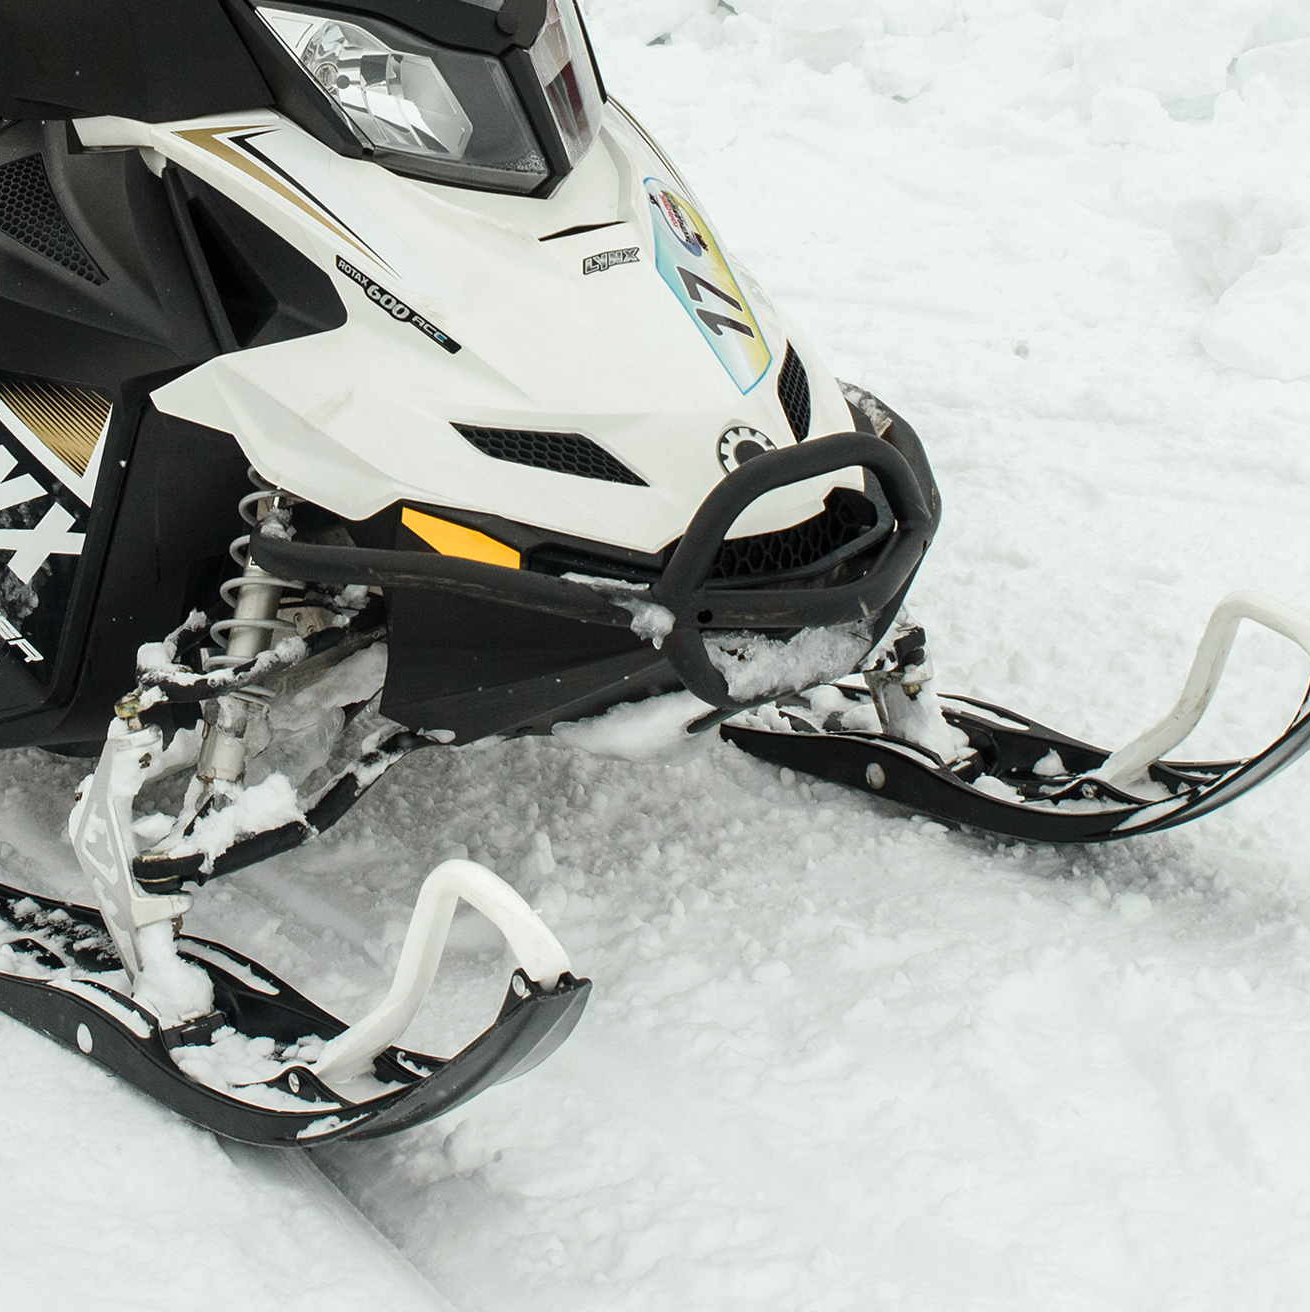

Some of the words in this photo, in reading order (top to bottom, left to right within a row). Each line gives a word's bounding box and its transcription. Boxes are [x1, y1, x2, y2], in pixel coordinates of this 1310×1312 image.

[583, 247, 640, 275] LYNX
[337, 259, 370, 287] ROTAX
[366, 284, 410, 319] 600
[411, 315, 448, 343] ACE
[675, 265, 756, 339] 17
